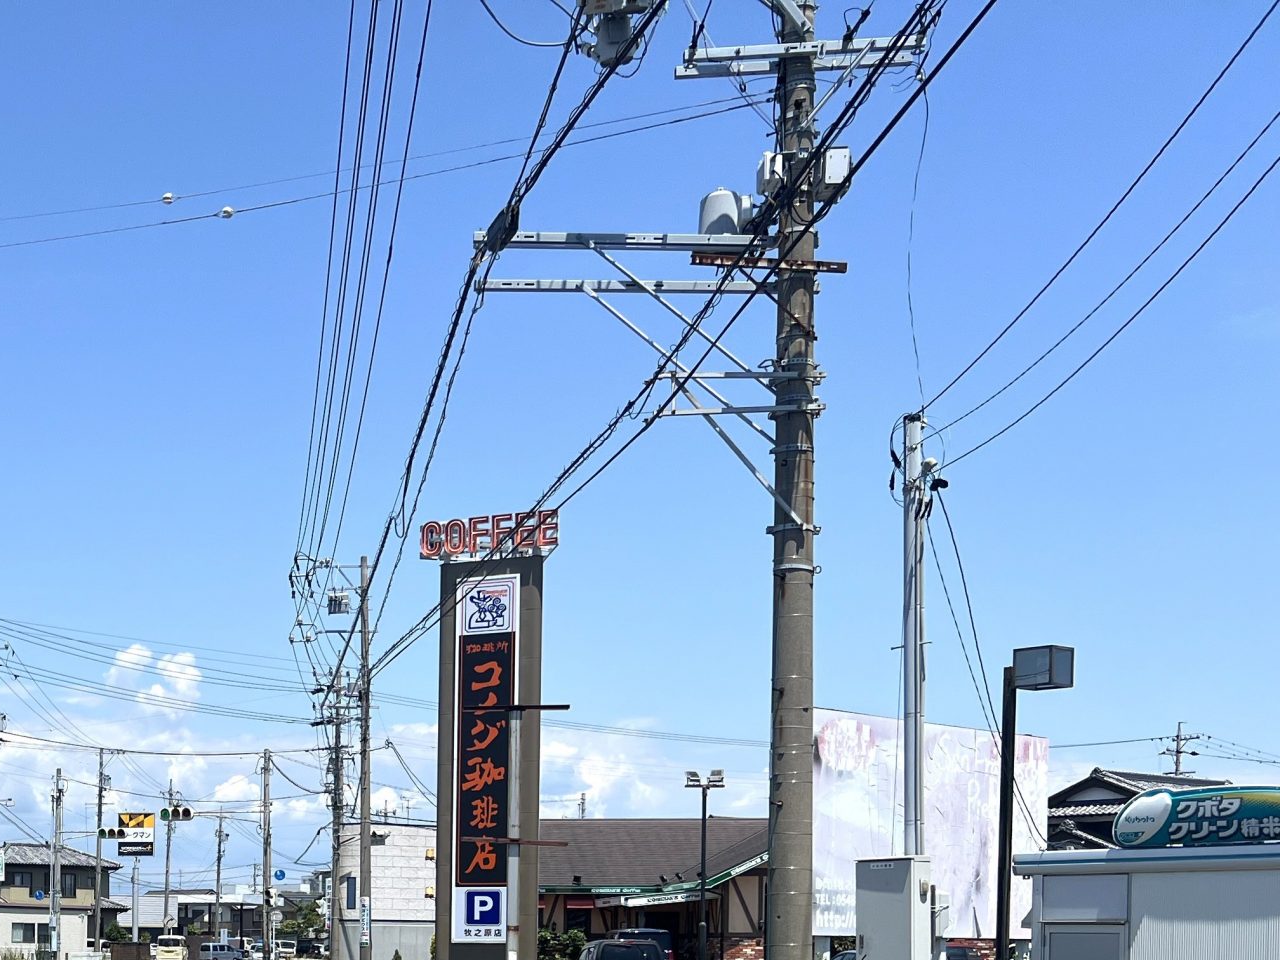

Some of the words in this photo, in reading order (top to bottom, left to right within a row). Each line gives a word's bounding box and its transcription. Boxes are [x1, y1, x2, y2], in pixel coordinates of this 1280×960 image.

[420, 509, 558, 557] COFFEE
[1176, 796, 1241, 819] クボタ
[1125, 816, 1155, 824] Kubota
[473, 895, 494, 921] P
[464, 928, 502, 937] 牧之原店
